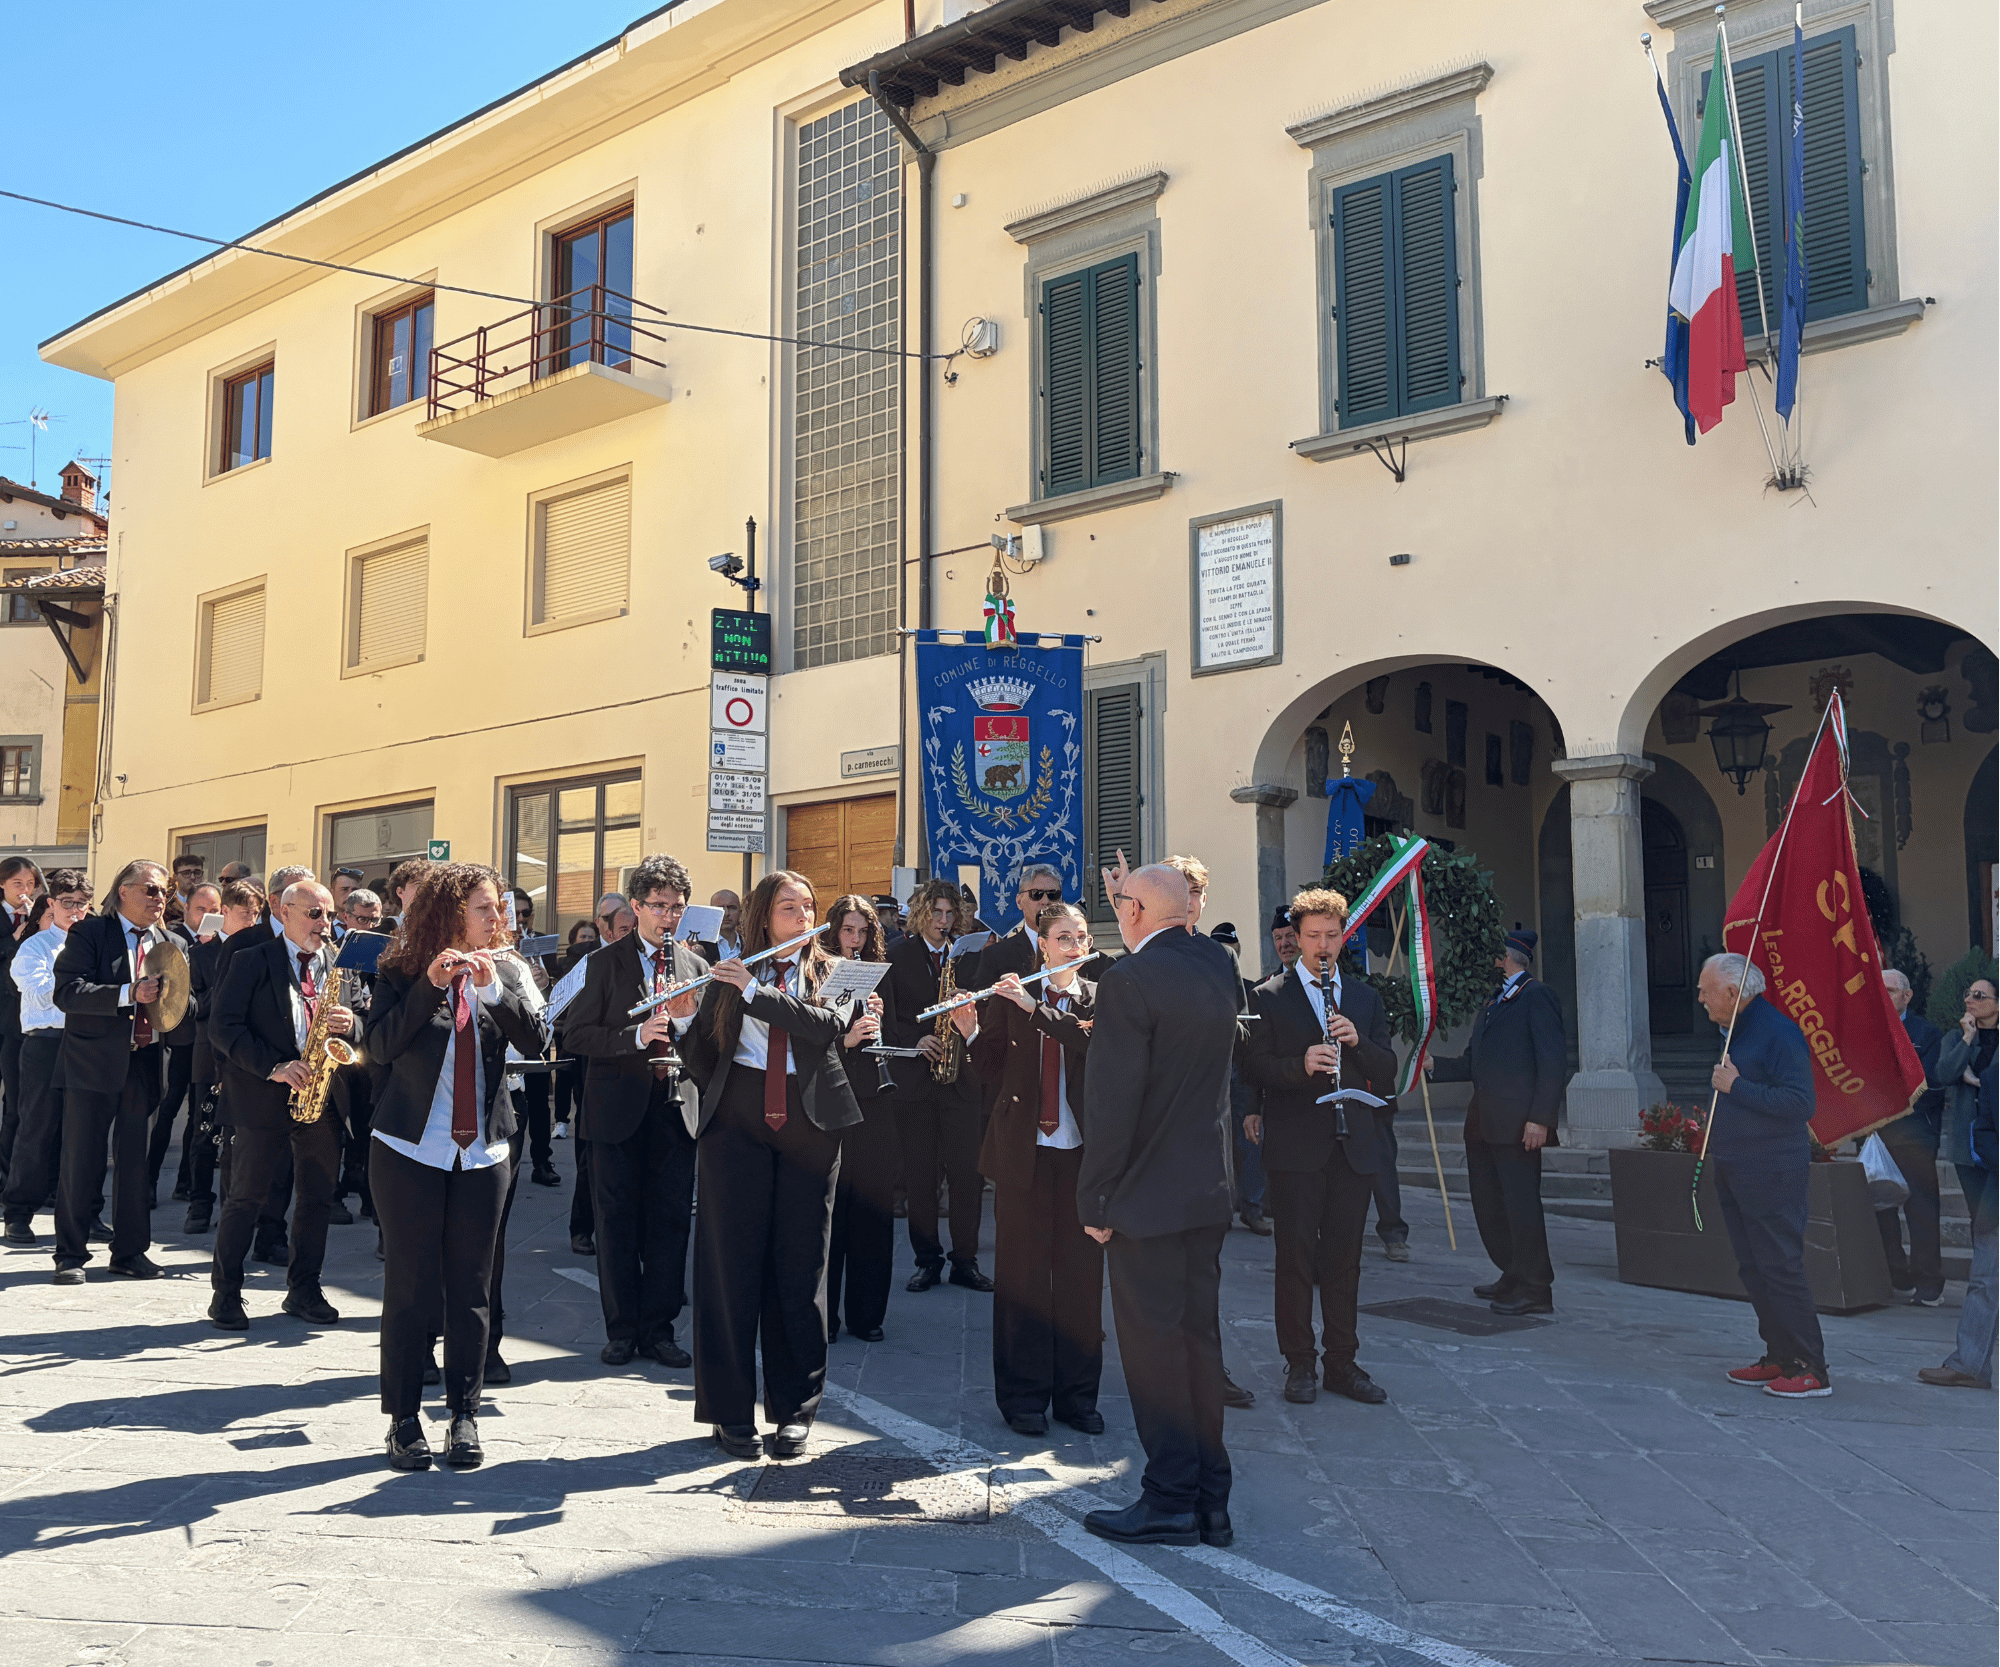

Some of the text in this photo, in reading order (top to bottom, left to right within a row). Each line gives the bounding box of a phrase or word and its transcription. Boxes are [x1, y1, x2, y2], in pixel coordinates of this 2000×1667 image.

[1215, 528, 1235, 536] MUNICIPIO
[1246, 522, 1262, 530] POPOLO
[1228, 534, 1249, 543] REGGELLO
[1201, 566, 1229, 578] VITTORIO
[1232, 558, 1265, 572] EMANUELE
[1247, 580, 1266, 588] GIURATA
[1239, 589, 1263, 598] BATTAGLIA
[1245, 626, 1265, 634] ITALIANA
[724, 634, 751, 646] NON
[1233, 645, 1263, 654] CAMPIDOGLIO
[934, 655, 1067, 688] COMUNE DI REGGELLO
[1761, 929, 1784, 977] LEGA
[1780, 979, 1864, 1094] REGGELLO
